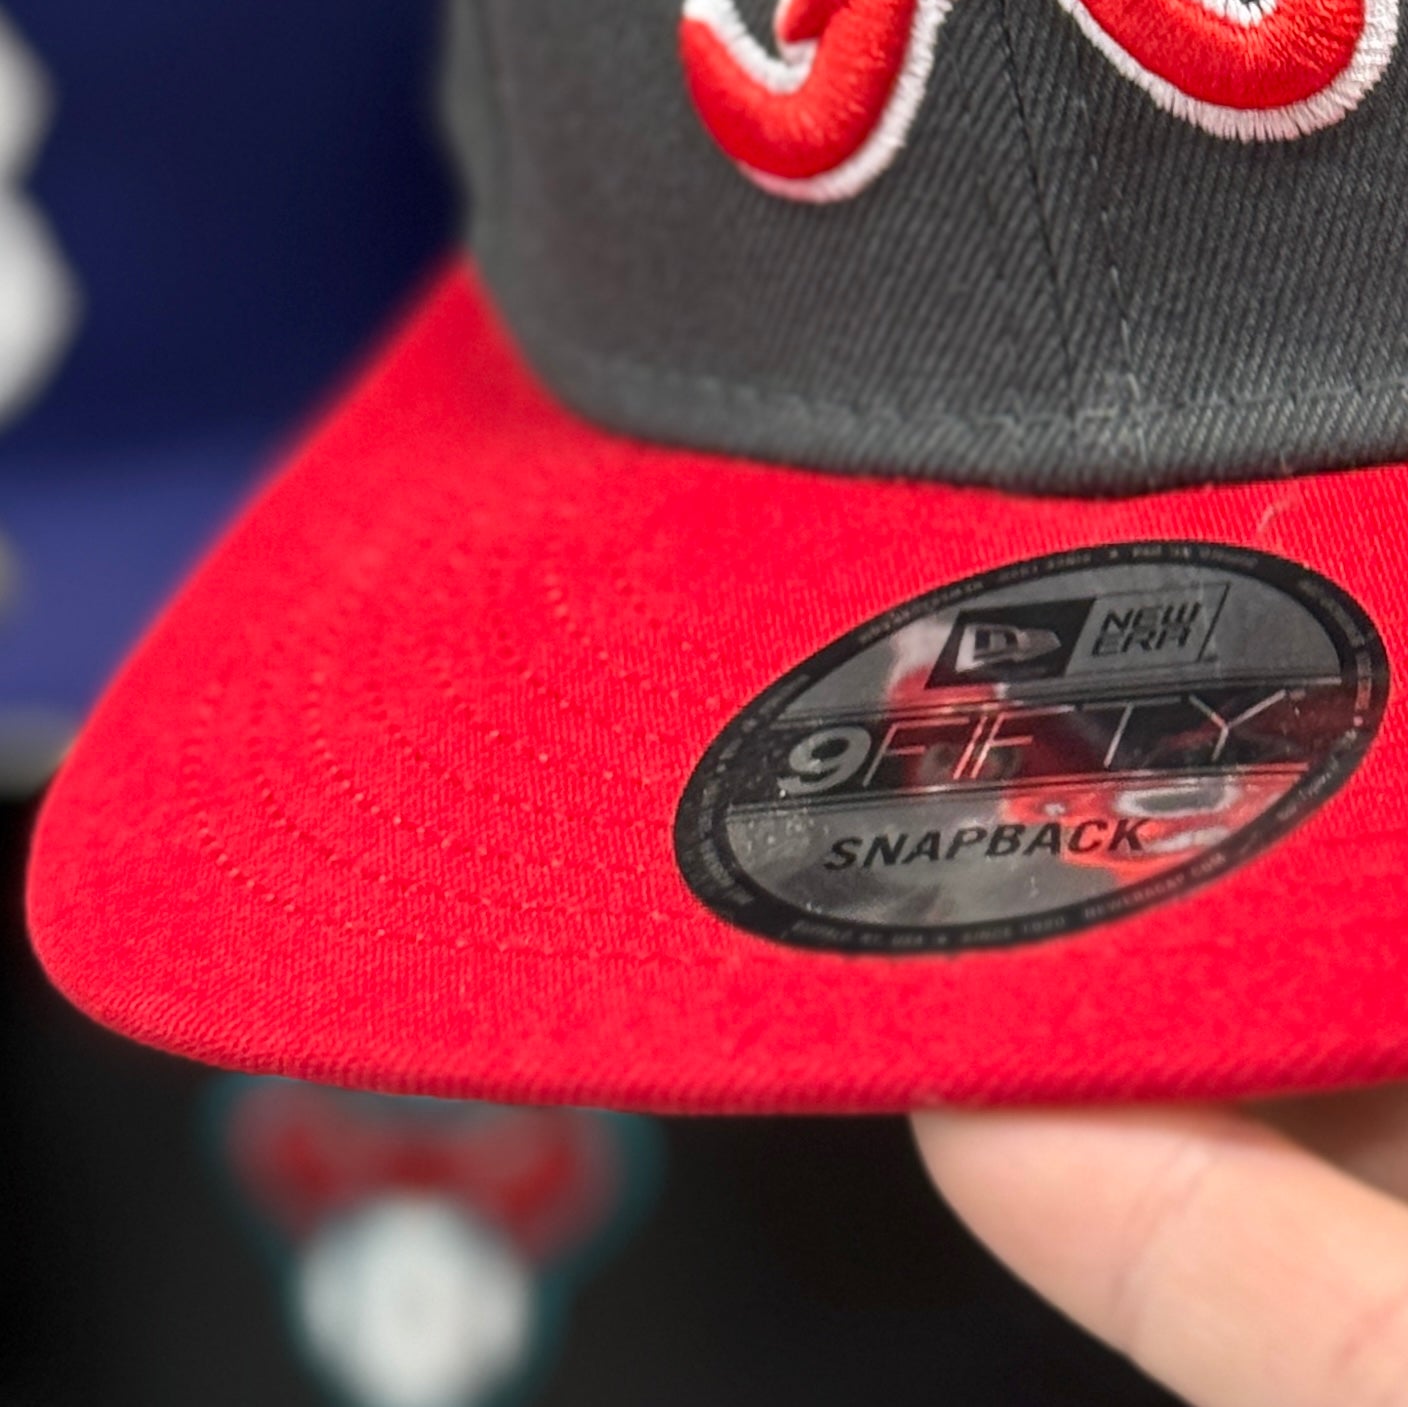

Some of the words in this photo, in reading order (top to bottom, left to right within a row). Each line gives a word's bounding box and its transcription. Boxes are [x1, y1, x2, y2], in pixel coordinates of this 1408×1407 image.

[1101, 602, 1200, 633] NEW
[1092, 625, 1191, 657] ERA
[777, 689, 1287, 793] 9FIFTY
[824, 818, 1150, 871] SNAPBACK
